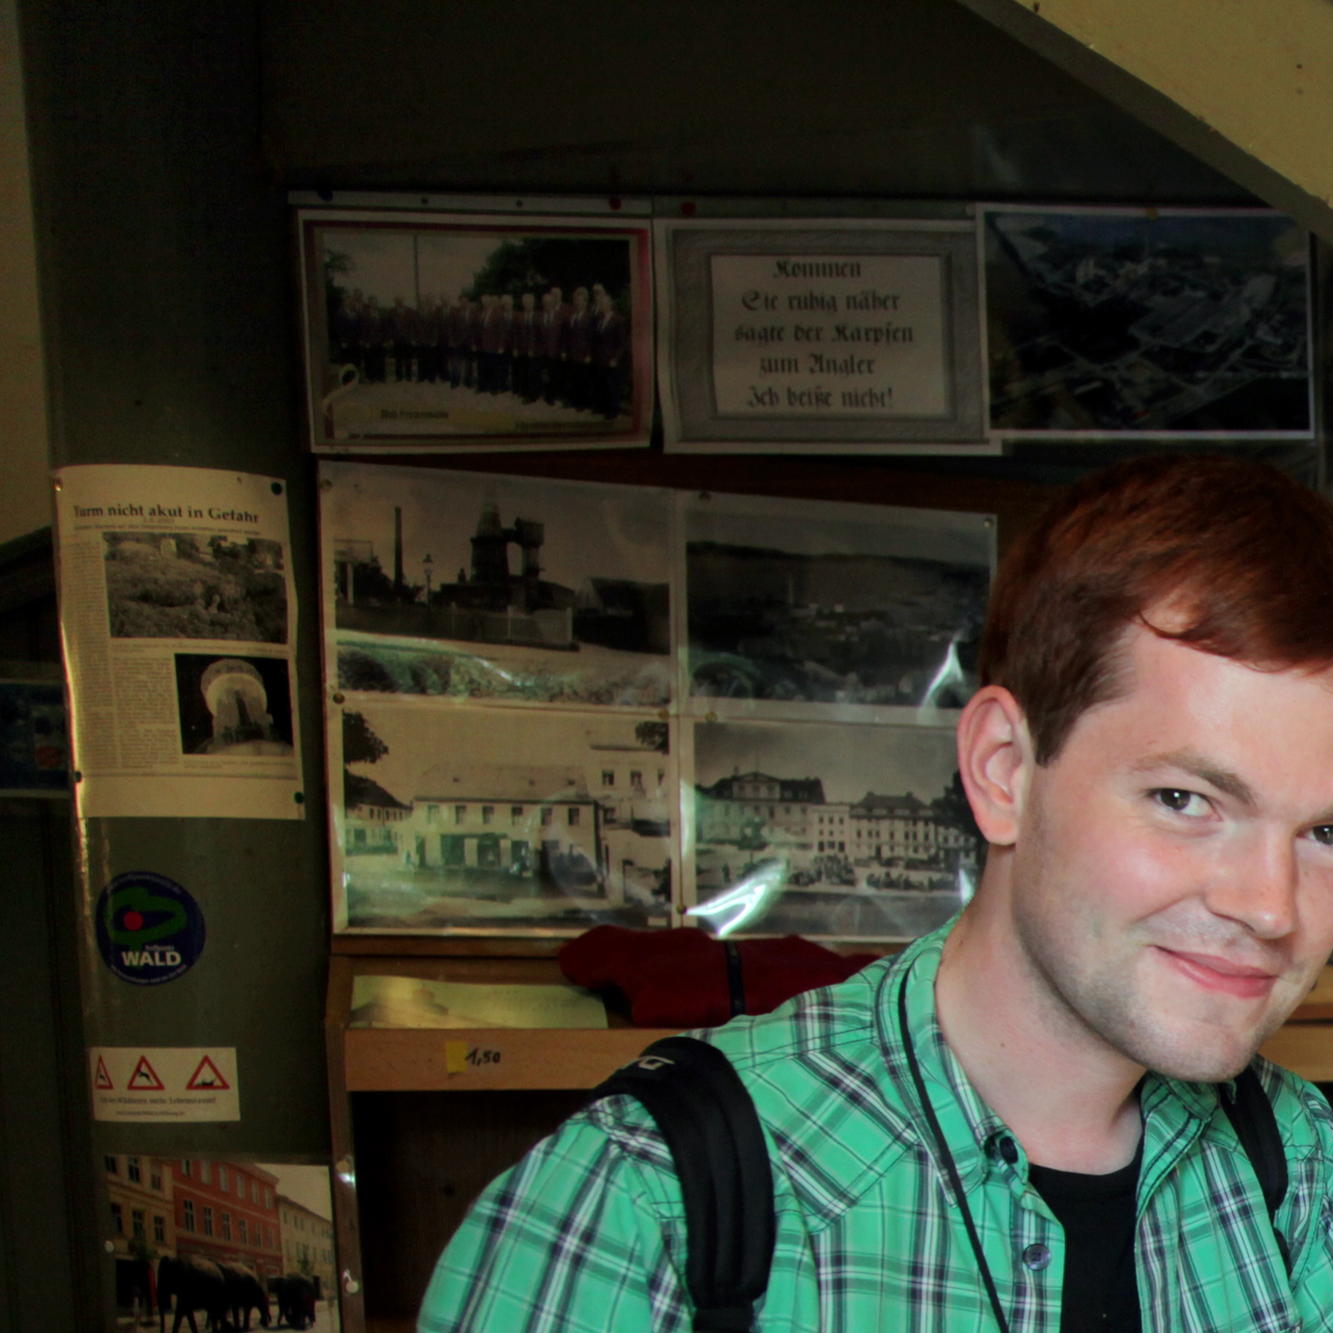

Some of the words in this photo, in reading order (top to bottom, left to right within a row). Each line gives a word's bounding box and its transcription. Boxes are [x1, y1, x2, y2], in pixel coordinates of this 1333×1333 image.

[773, 260, 861, 278] Kommen
[741, 290, 777, 311] Sie
[787, 289, 838, 312] ruhig
[846, 289, 901, 311] näher
[734, 324, 784, 345] sagte
[794, 324, 824, 342] der
[832, 322, 913, 344] Karpfen
[759, 356, 799, 377] zum
[809, 353, 875, 376] Angler
[747, 386, 779, 408] Ich
[787, 386, 832, 408] beiße
[841, 387, 893, 407] nicht!
[73, 505, 103, 518] Turm
[108, 504, 144, 518] nicht
[148, 504, 182, 518] akut
[188, 506, 203, 519] in
[208, 507, 259, 523] Gefahr
[121, 951, 182, 967] WALD
[464, 1047, 501, 1066] 1,50
